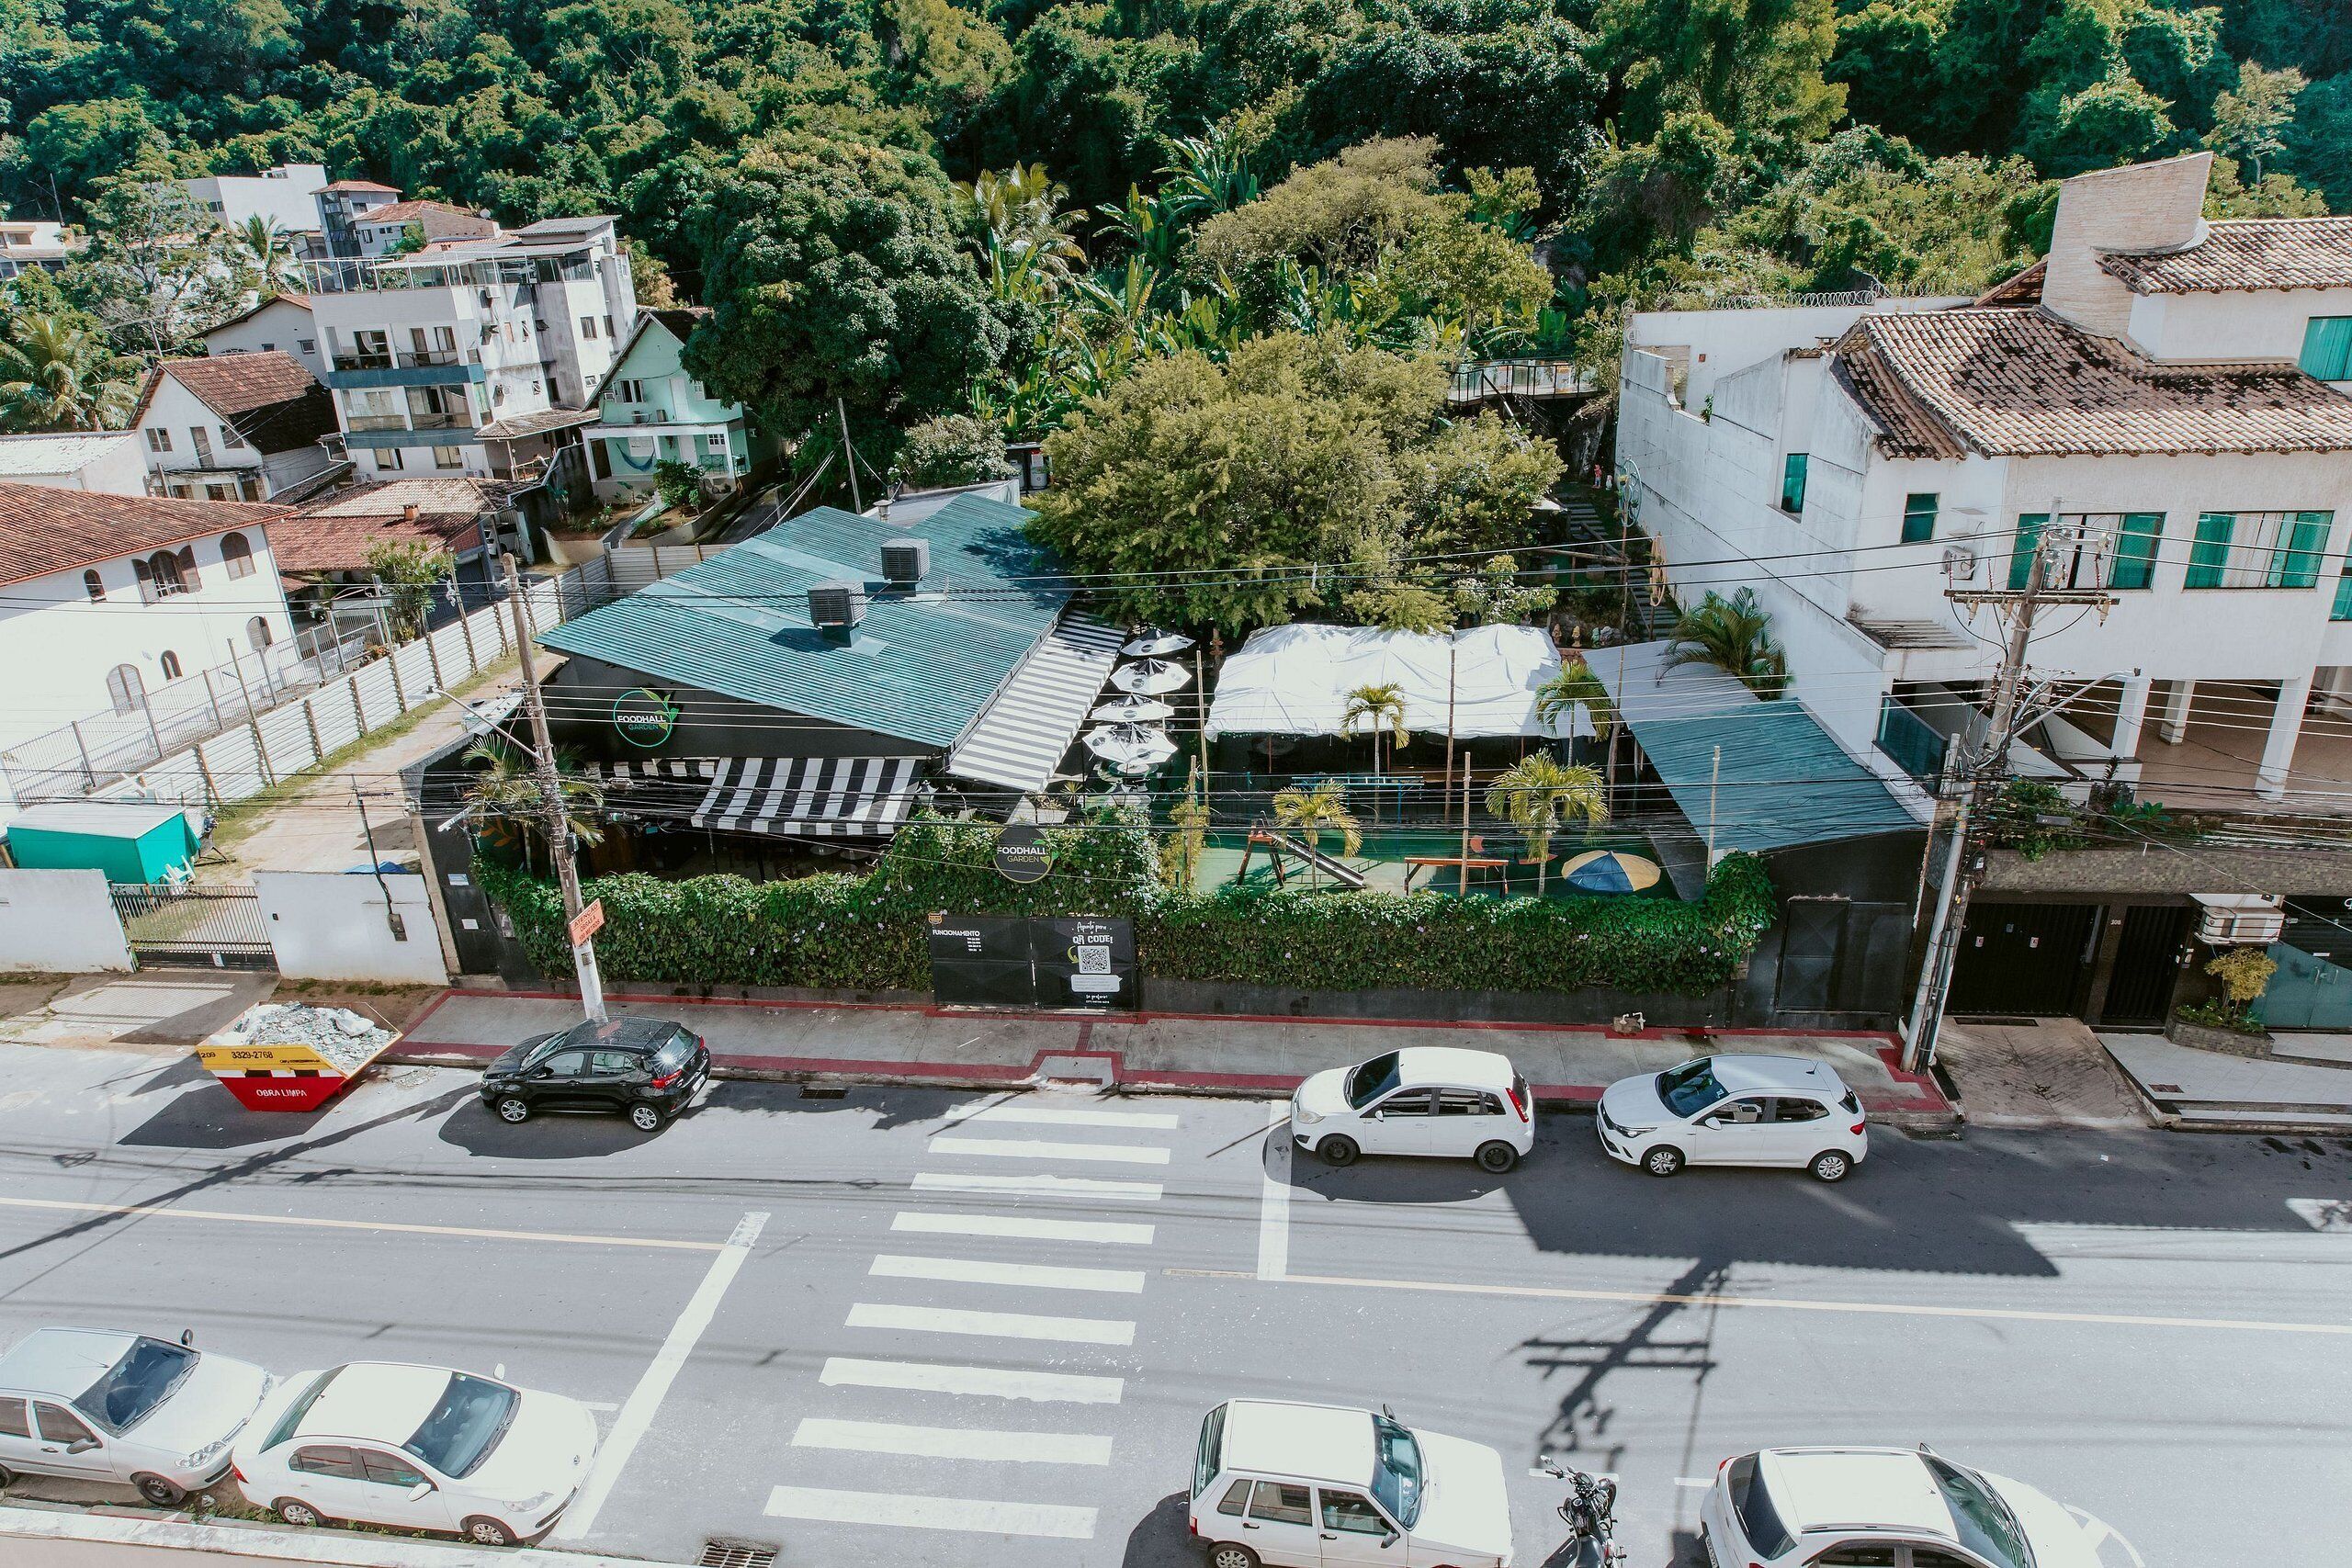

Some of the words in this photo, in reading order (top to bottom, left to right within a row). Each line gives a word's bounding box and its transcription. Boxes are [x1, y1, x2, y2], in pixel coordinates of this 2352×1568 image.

[617, 715, 666, 723] FOODHALL
[997, 846, 1048, 855] FOODHALL
[932, 929, 981, 937] FUNCIONAMENTO
[1072, 934, 1085, 944] QR
[231, 1051, 274, 1059] 3329-2768
[255, 1089, 280, 1097] OBRA
[280, 1089, 308, 1098] LIMPA
